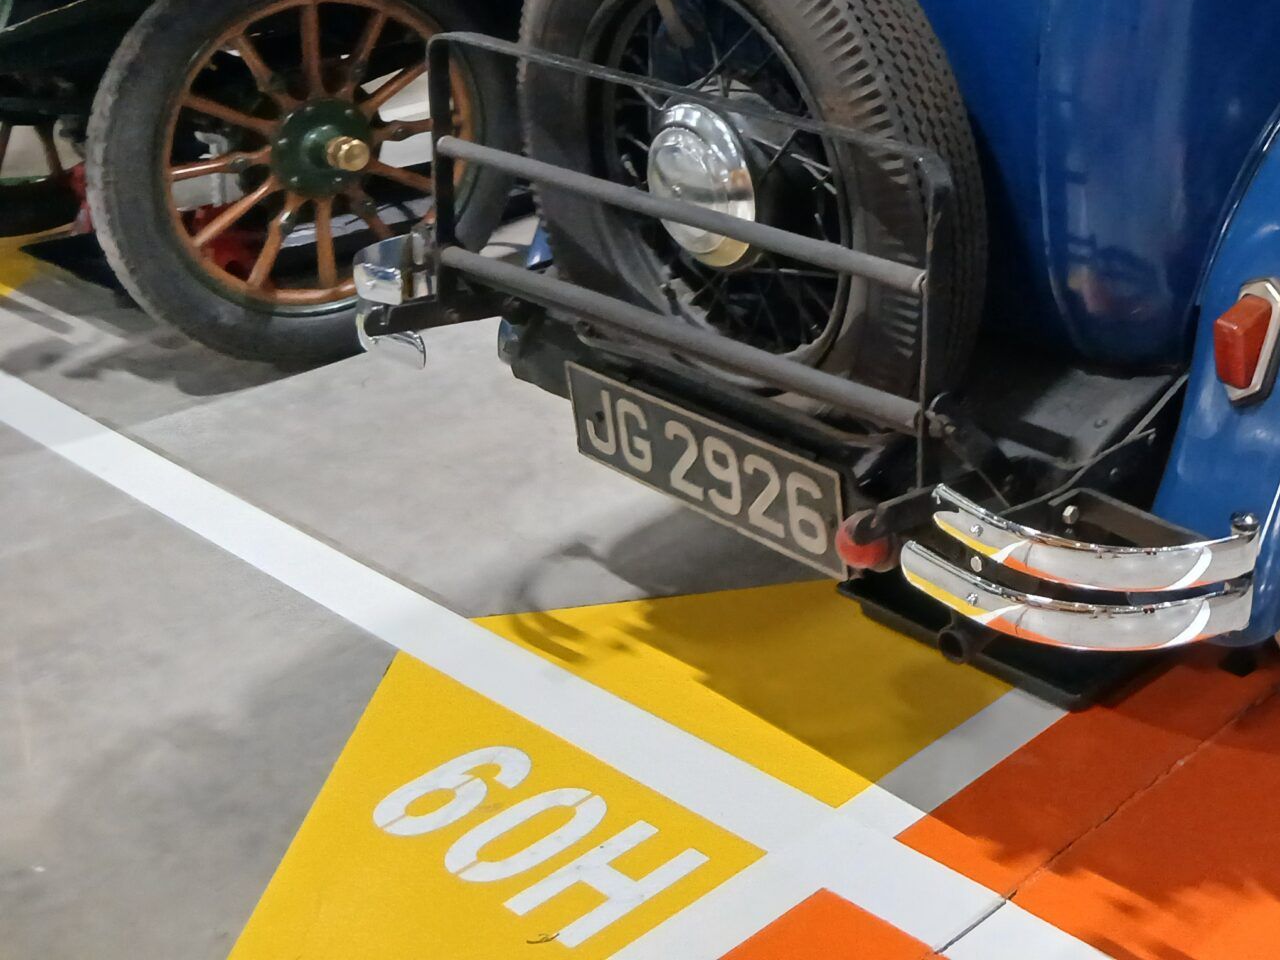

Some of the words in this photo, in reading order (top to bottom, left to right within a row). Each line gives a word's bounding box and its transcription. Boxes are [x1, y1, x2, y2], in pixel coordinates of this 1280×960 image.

[585, 390, 653, 473] JG
[664, 420, 828, 555] 2926
[372, 745, 711, 949] 60H
